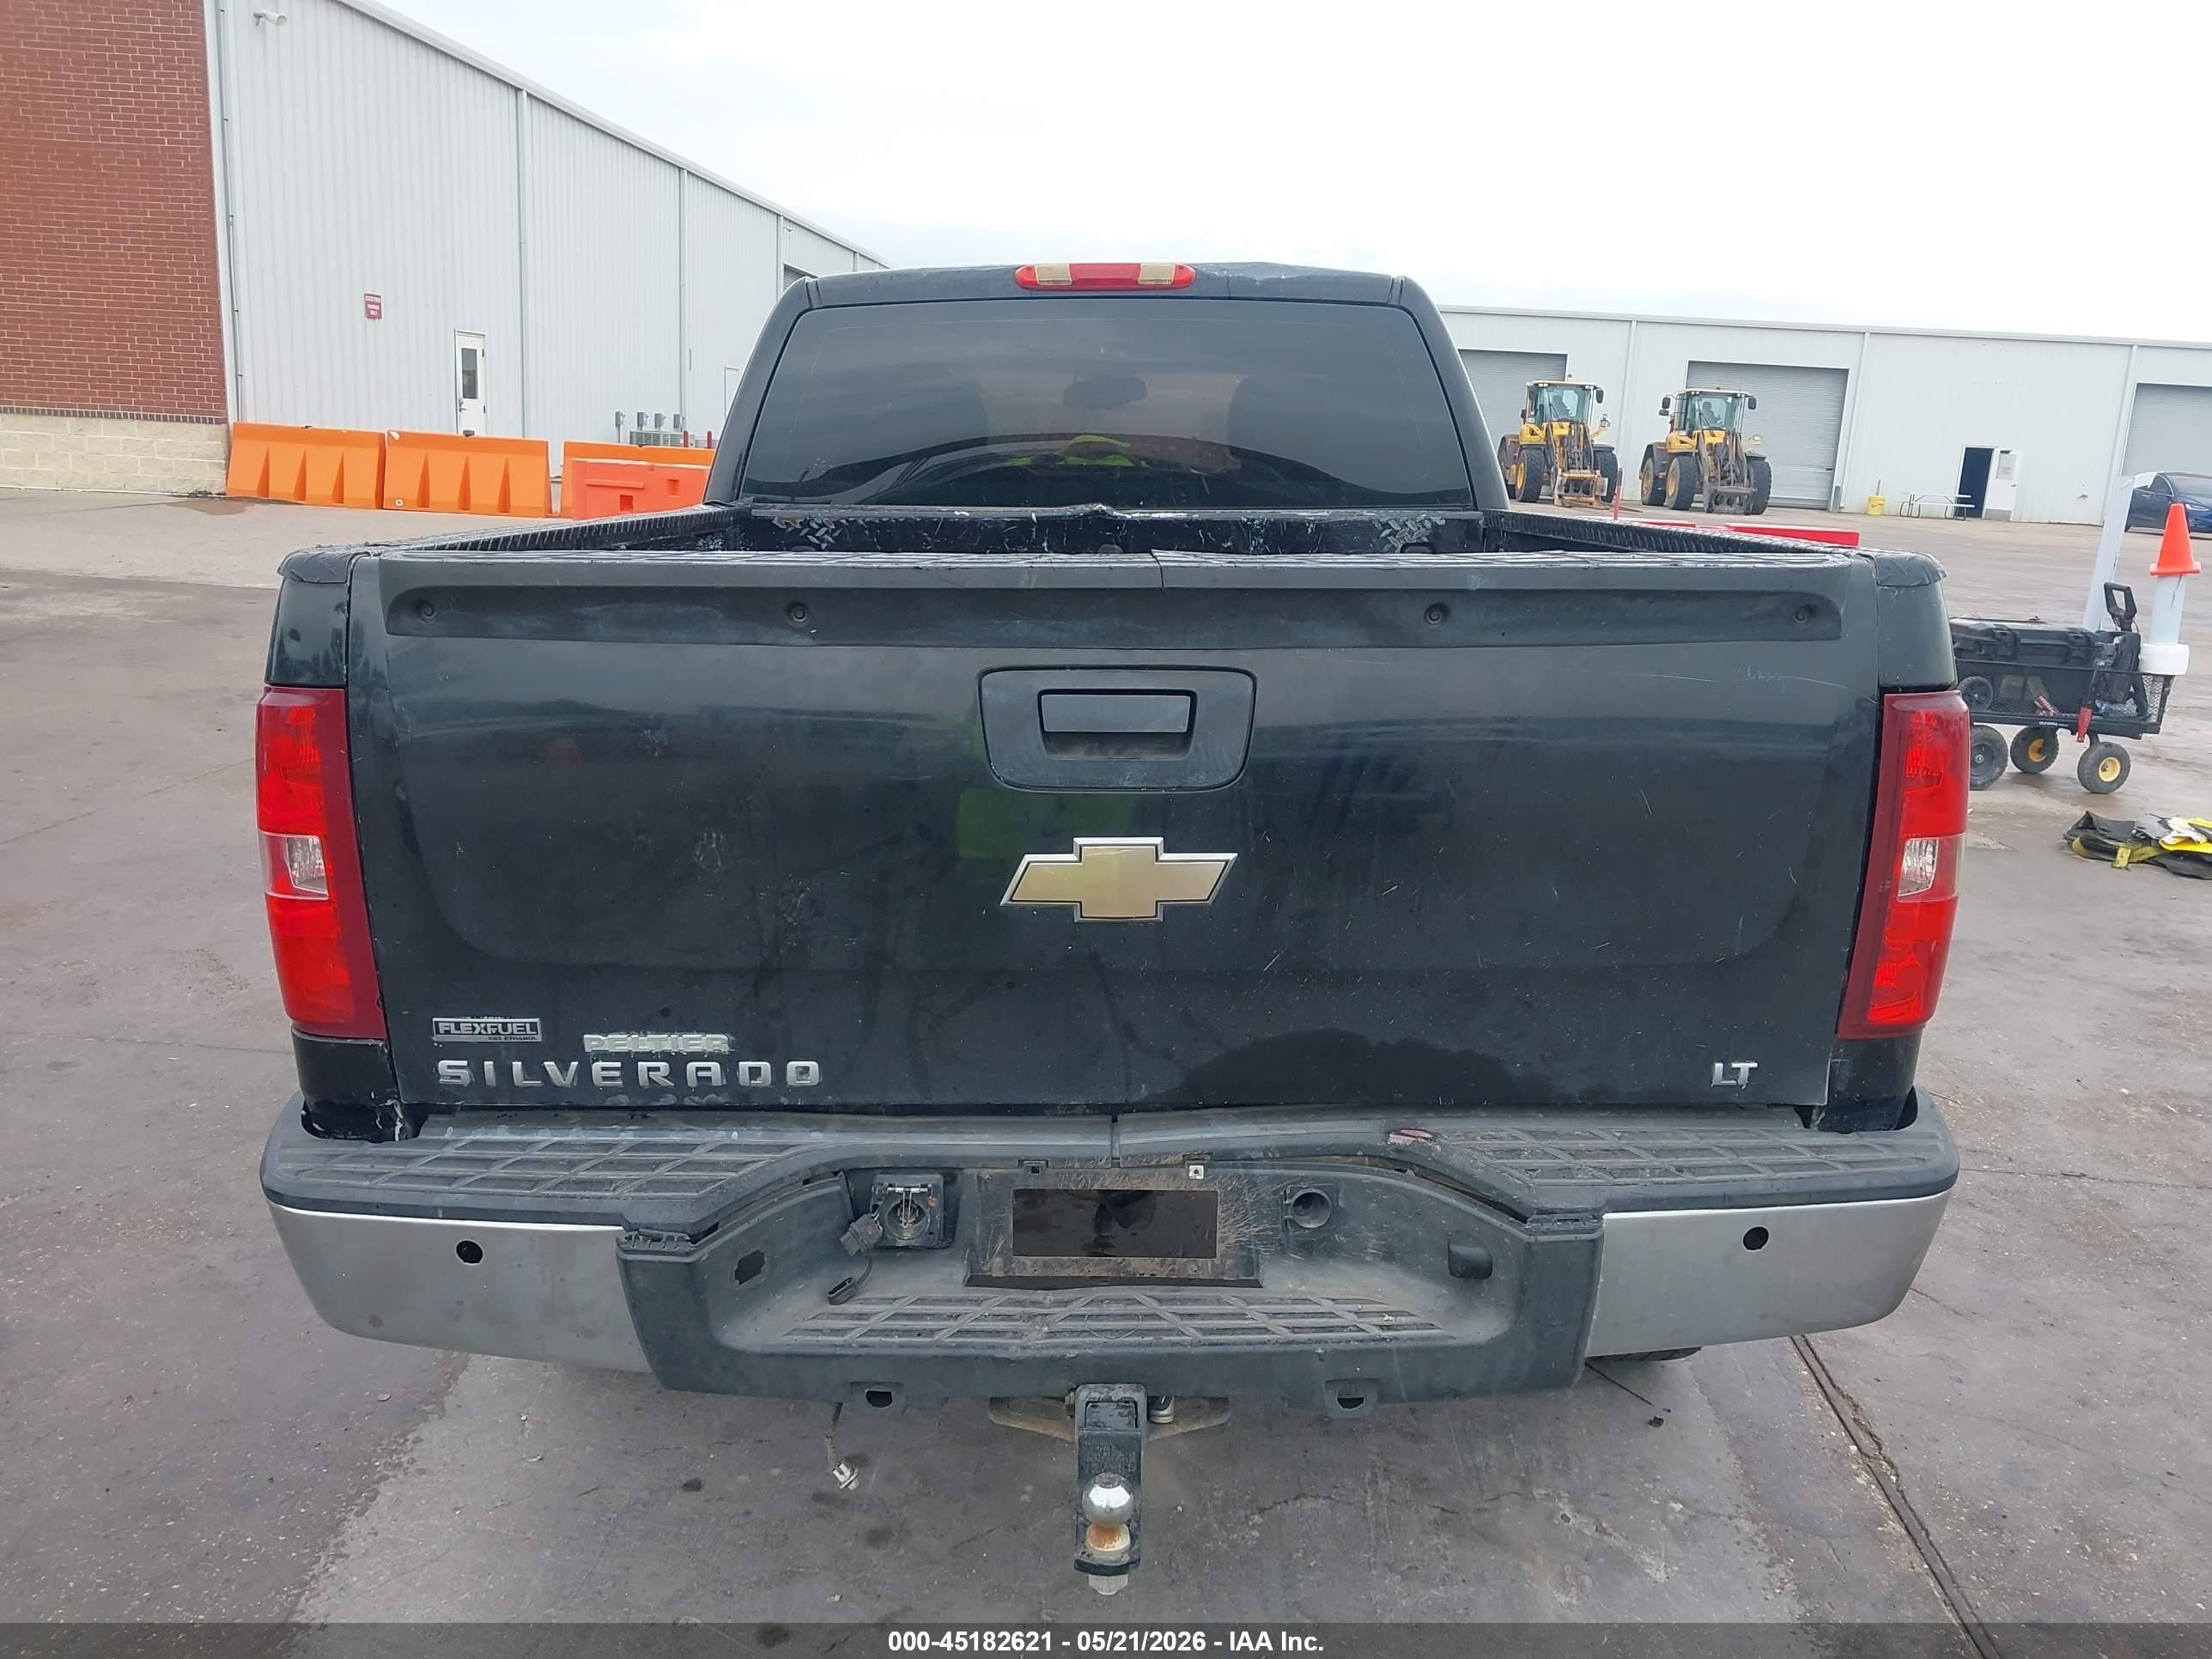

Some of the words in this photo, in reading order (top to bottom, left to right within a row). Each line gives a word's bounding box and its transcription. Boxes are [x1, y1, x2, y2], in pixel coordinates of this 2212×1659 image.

[438, 1022, 537, 1035] FLEXFUEL
[584, 1034, 730, 1052] PELTIER
[437, 1060, 820, 1087] SILVERADO
[1711, 1061, 1759, 1085] LT
